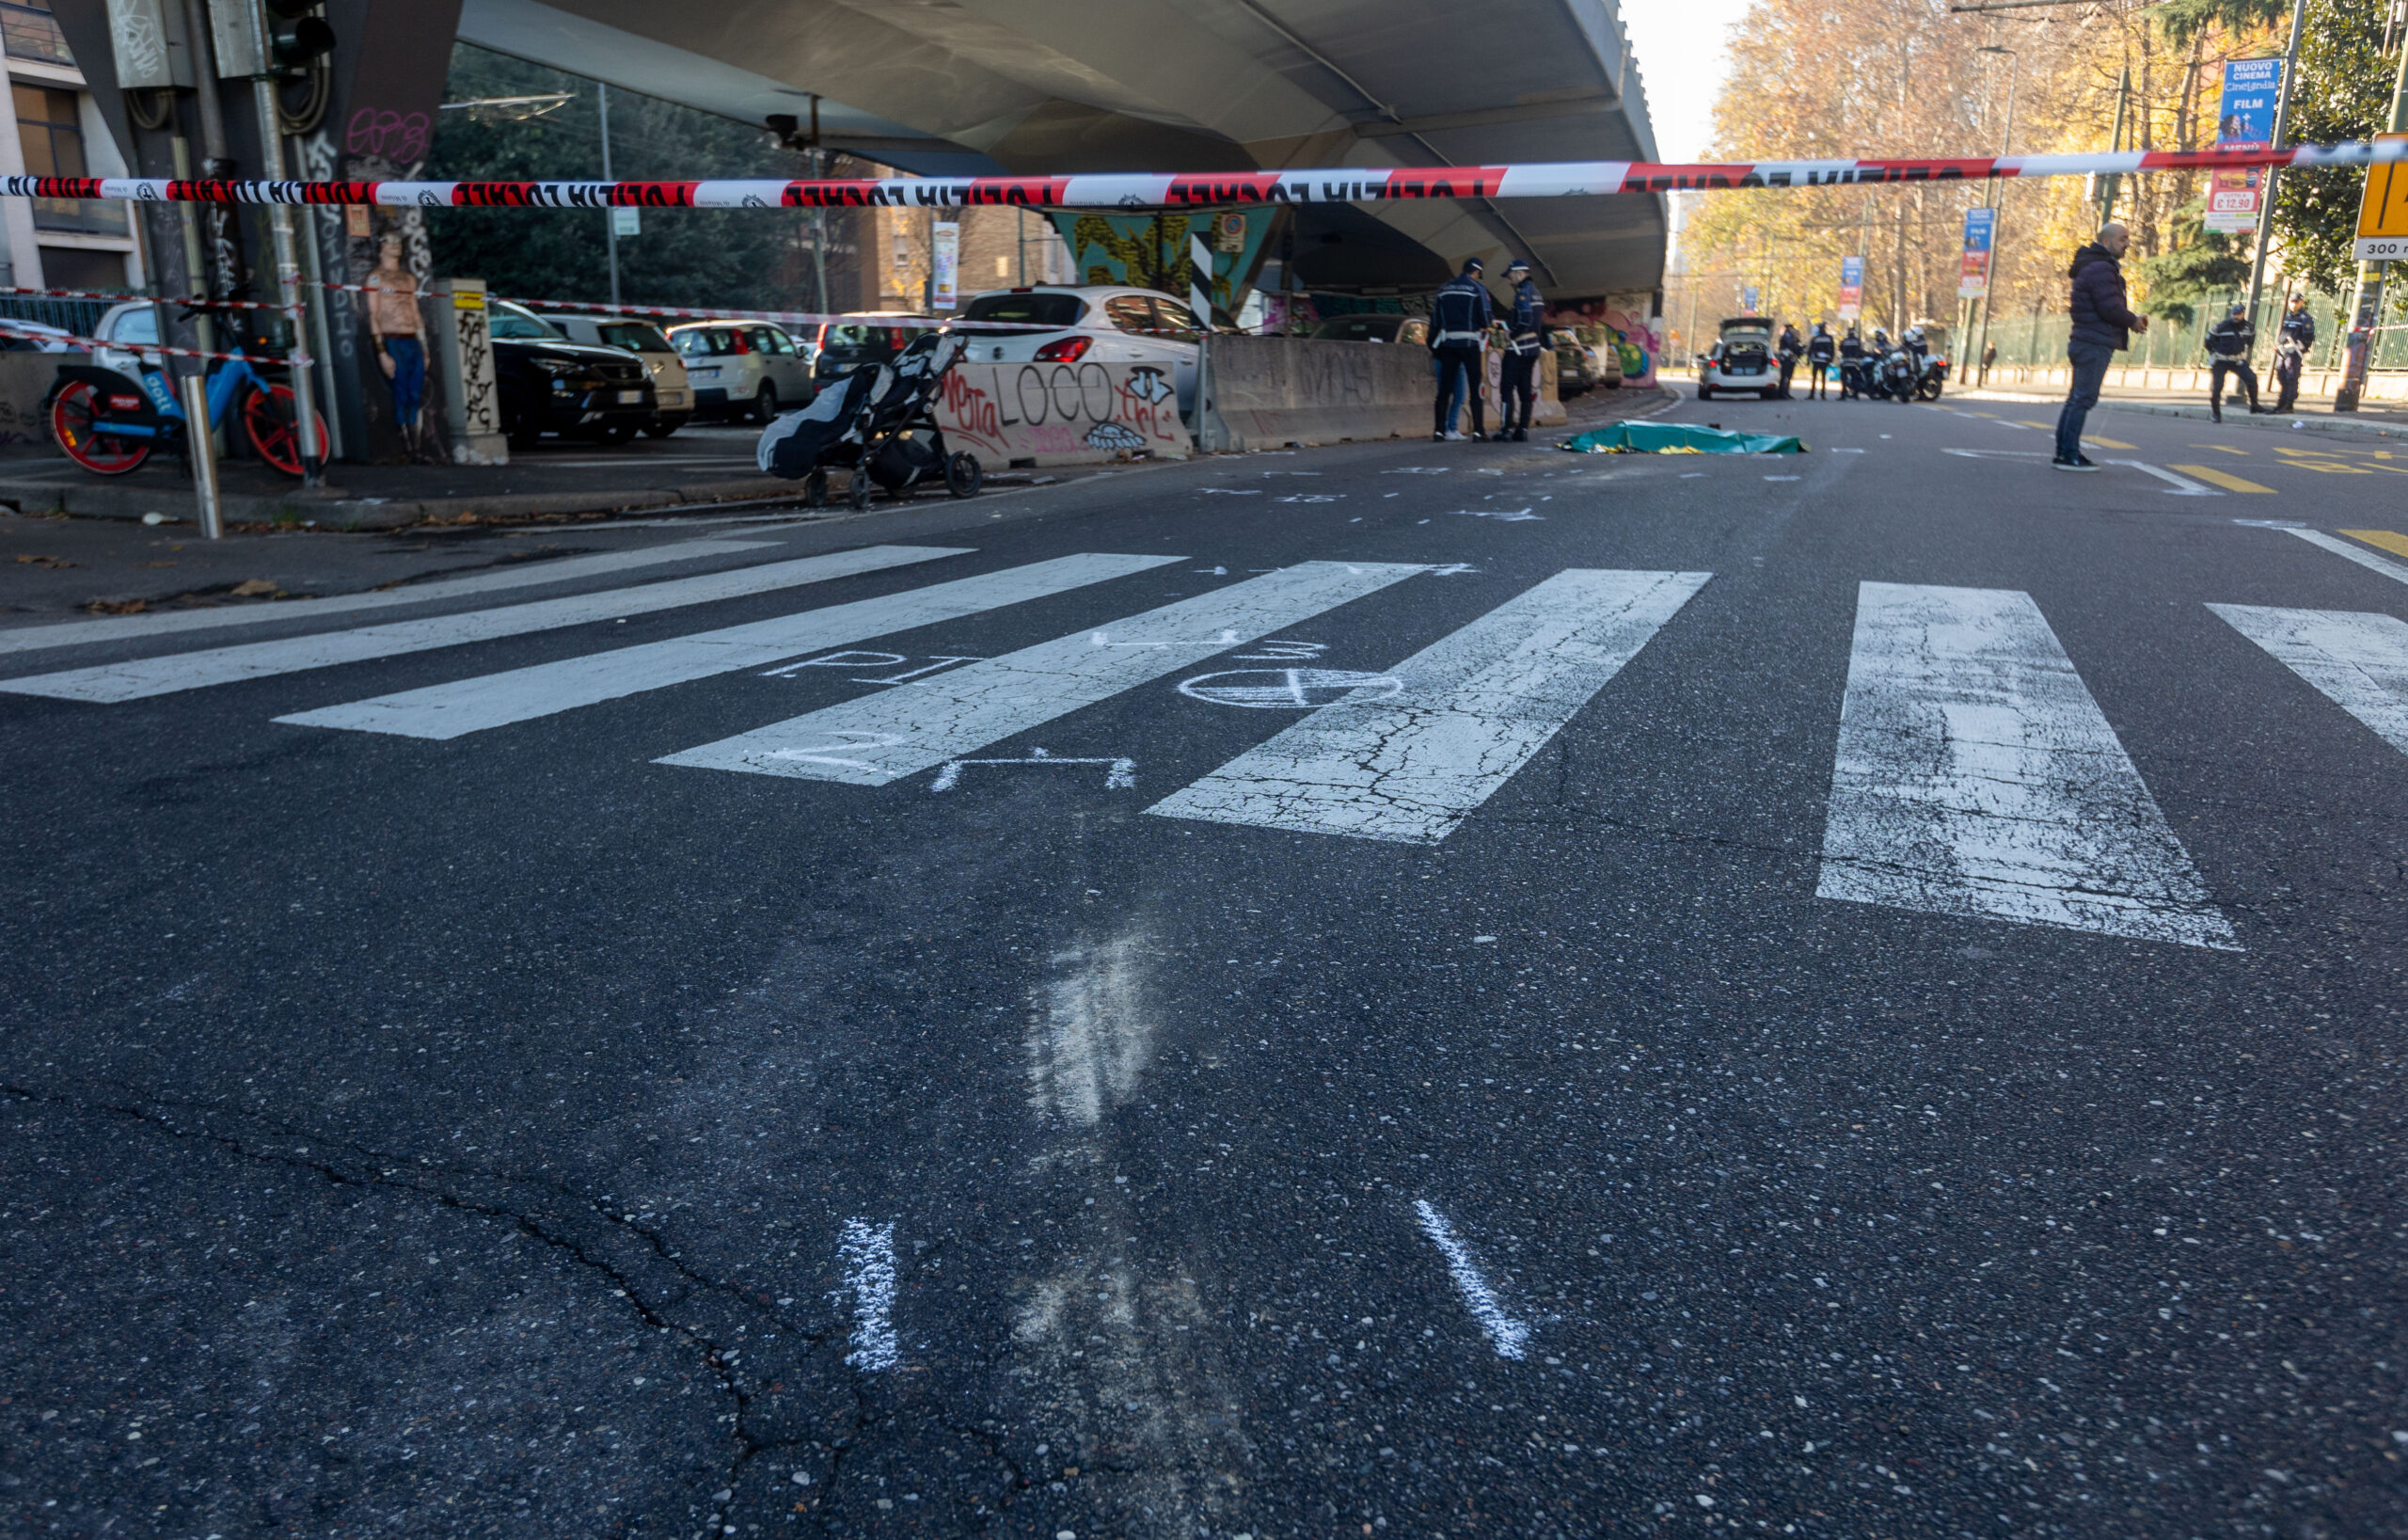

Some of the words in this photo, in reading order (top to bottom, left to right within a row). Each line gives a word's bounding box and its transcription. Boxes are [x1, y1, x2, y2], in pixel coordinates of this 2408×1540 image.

[2233, 71, 2272, 81] CINEMA
[2234, 62, 2273, 72] NUOVO
[2233, 99, 2263, 109] FILM
[170, 180, 261, 203] LOCALE
[267, 182, 373, 204] POLIZIA
[456, 183, 562, 207] LOCALE
[569, 184, 685, 207] POLIZIA
[2367, 244, 2398, 255] 300
[992, 362, 1114, 427] LOCO
